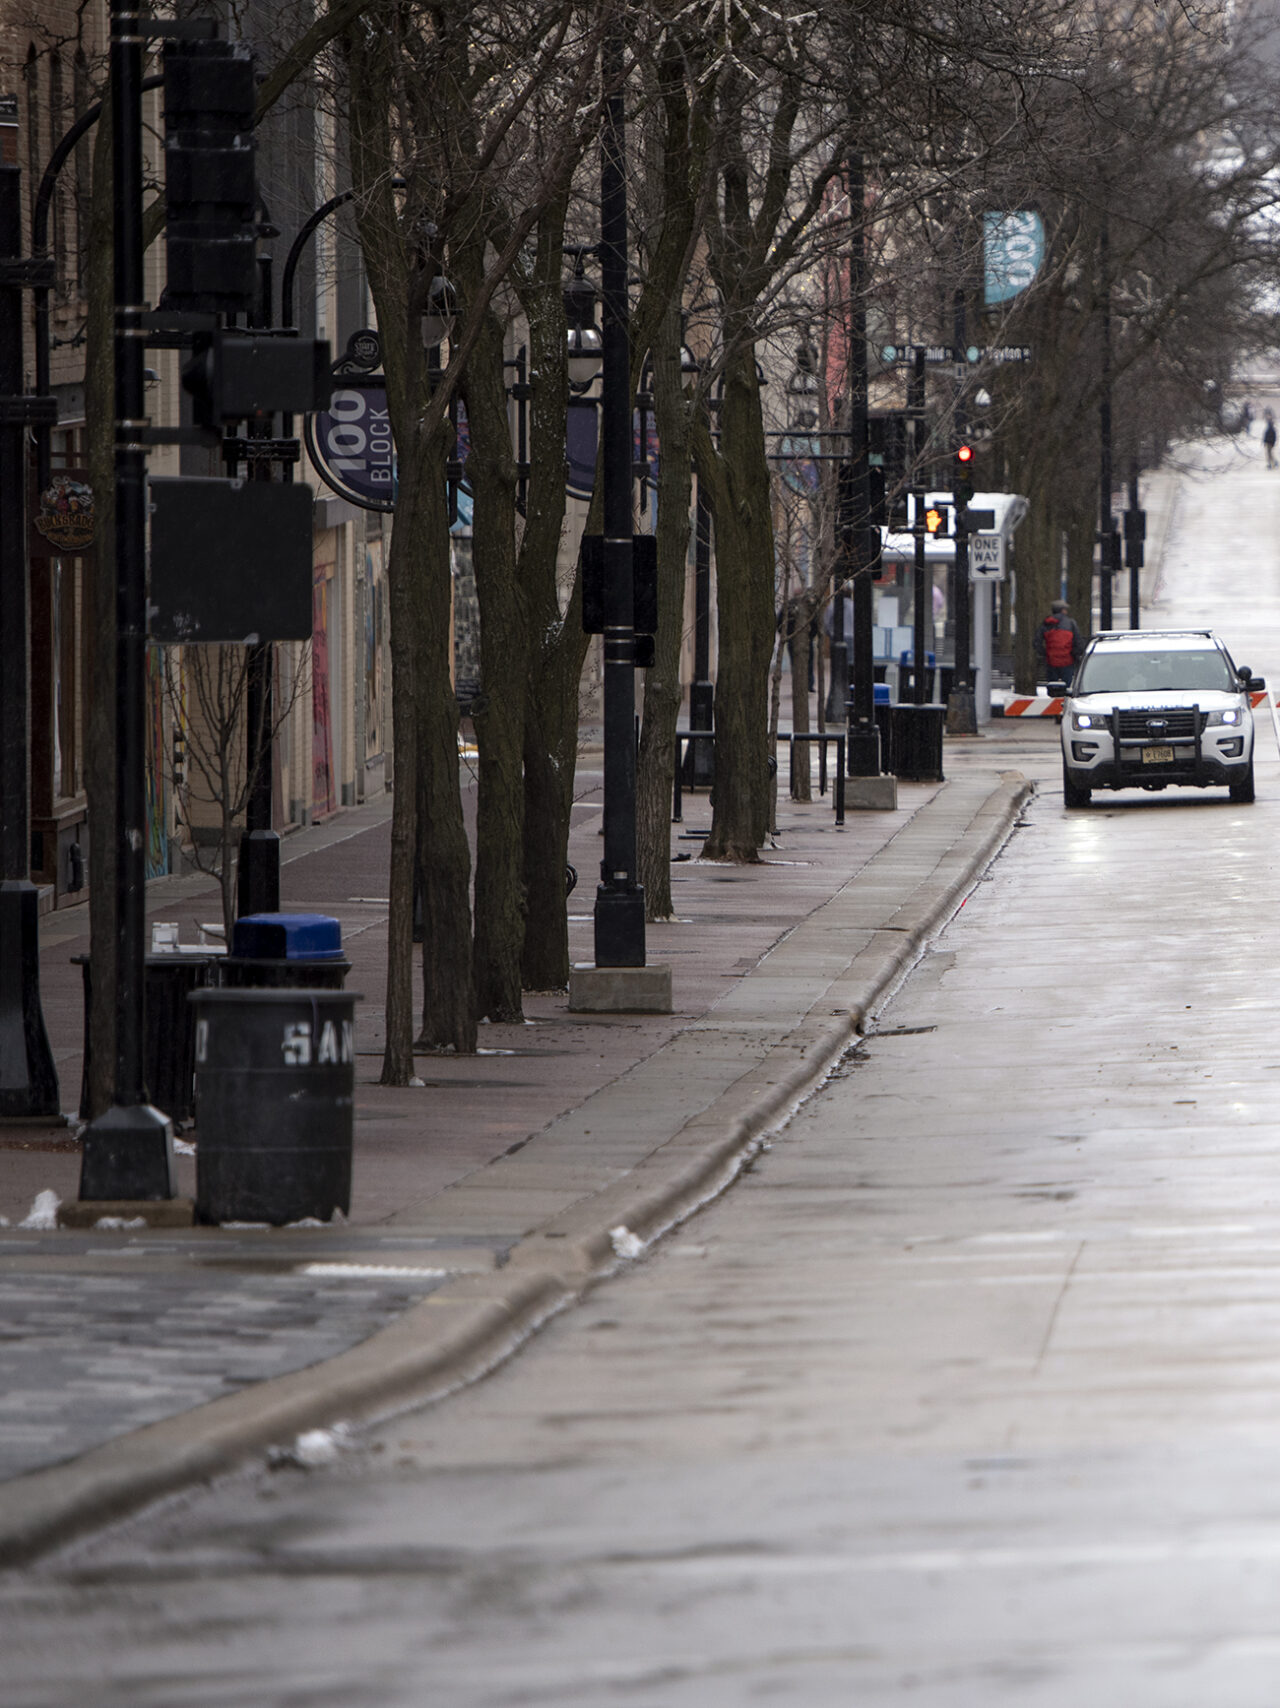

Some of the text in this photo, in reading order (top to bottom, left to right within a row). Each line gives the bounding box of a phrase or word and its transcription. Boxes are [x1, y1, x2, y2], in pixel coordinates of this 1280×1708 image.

[1003, 210, 1036, 287] 200
[327, 389, 367, 478] 100
[369, 408, 391, 482] BLOCK
[974, 539, 998, 550] ONE
[974, 551, 999, 562] WAY
